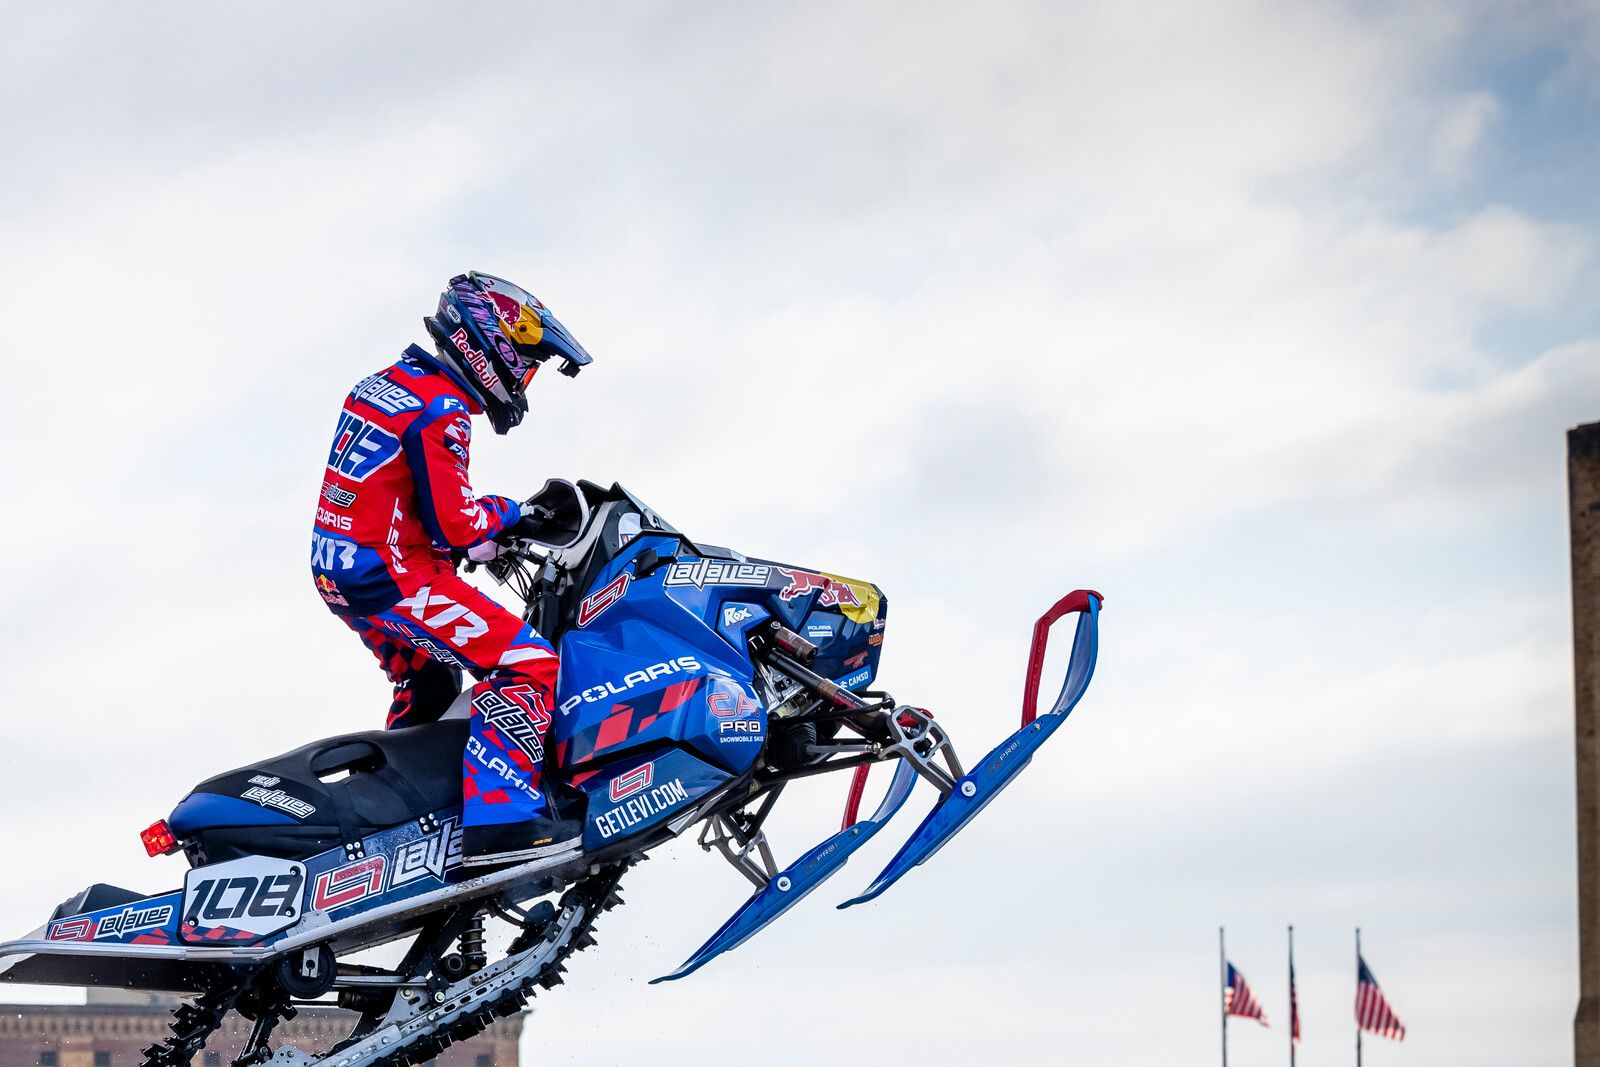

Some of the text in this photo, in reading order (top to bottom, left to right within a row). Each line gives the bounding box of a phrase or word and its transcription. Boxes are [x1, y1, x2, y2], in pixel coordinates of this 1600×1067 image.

[450, 327, 484, 362] Red
[470, 358, 500, 390] Bull
[559, 656, 702, 716] POLARIS
[719, 720, 761, 734] PRO
[595, 778, 689, 838] GETLEVI.COM
[185, 874, 304, 921] 108
